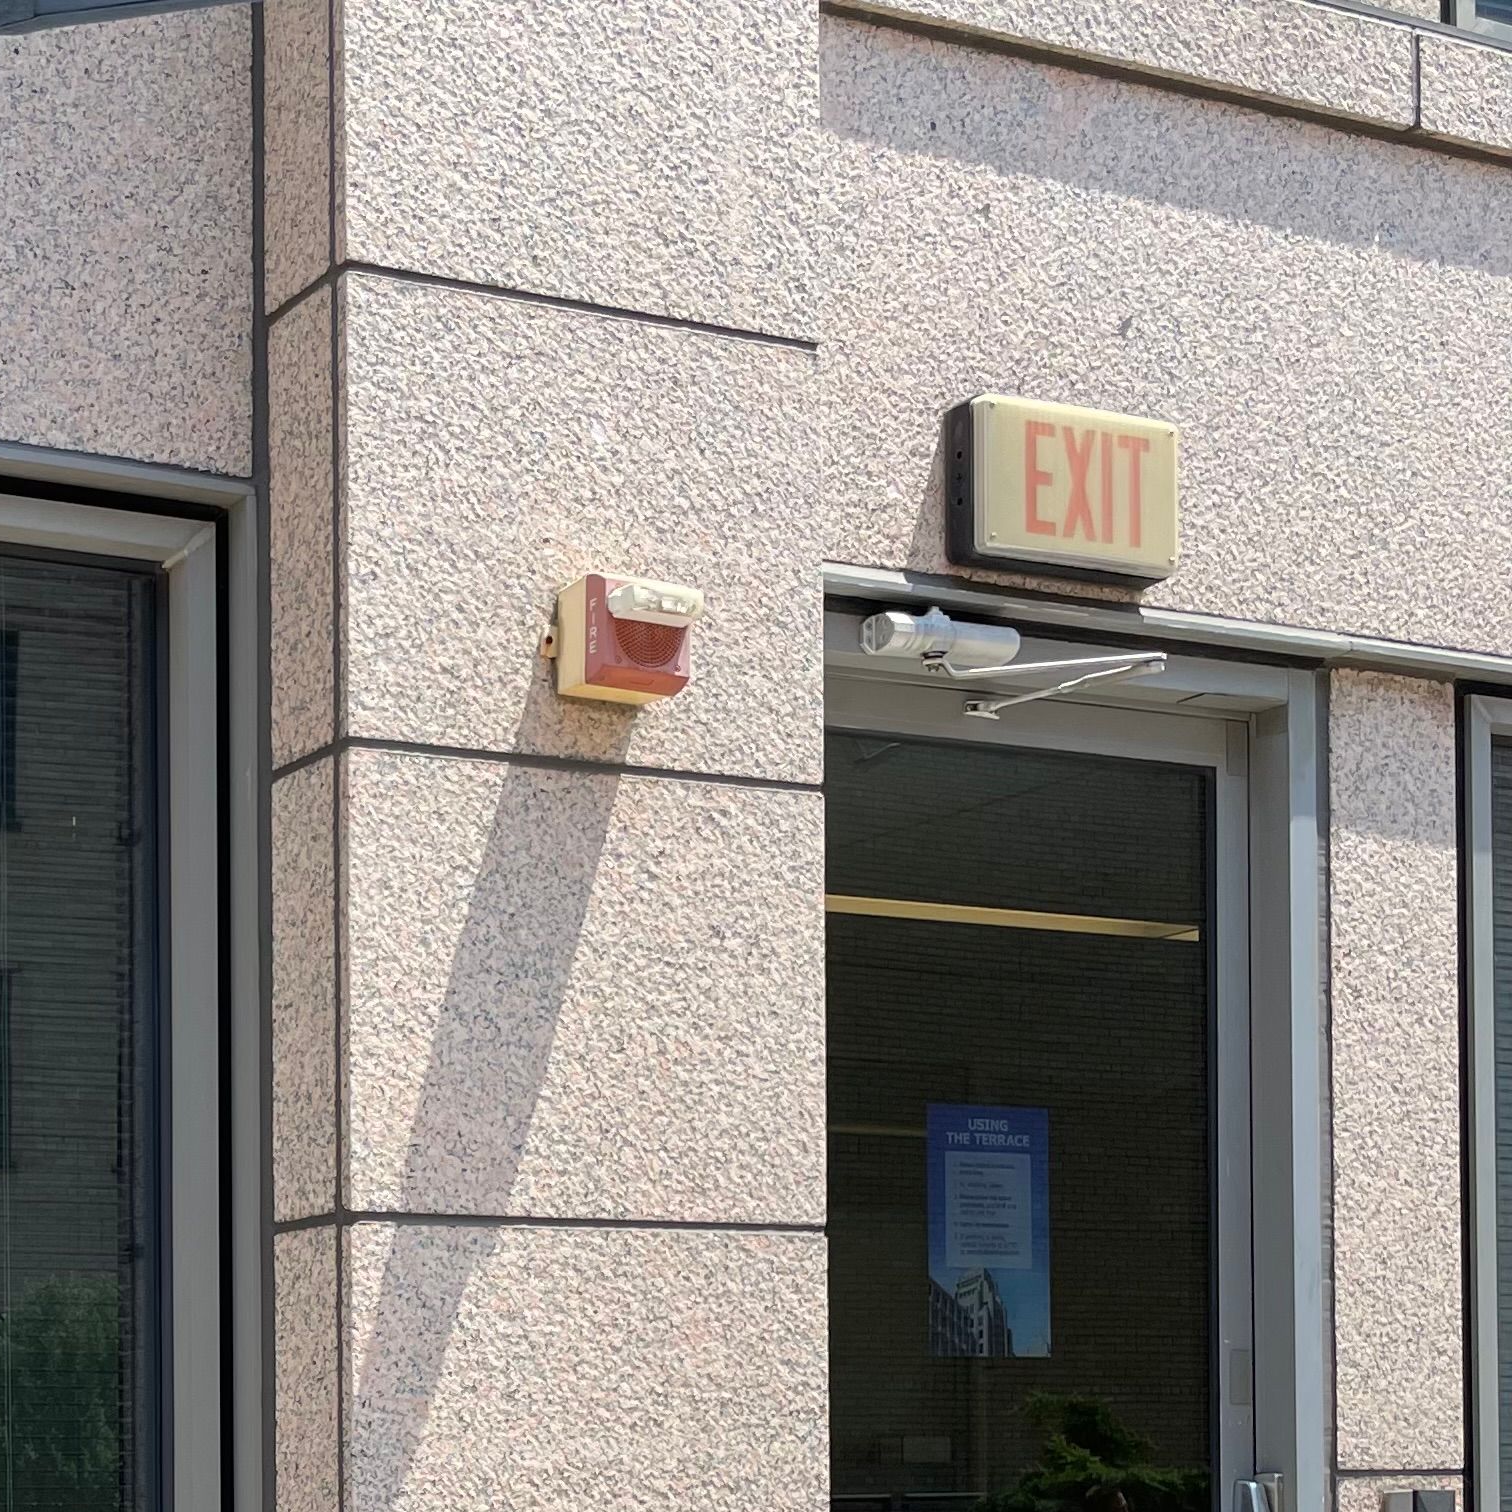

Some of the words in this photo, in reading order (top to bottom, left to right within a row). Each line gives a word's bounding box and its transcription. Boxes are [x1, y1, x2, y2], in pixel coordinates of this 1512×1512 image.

[1025, 419, 1150, 549] EXIT
[589, 597, 598, 654] FIRE
[946, 1131, 970, 1145] THE
[974, 1132, 1030, 1147] TERRACE
[968, 1118, 1009, 1132] USING
